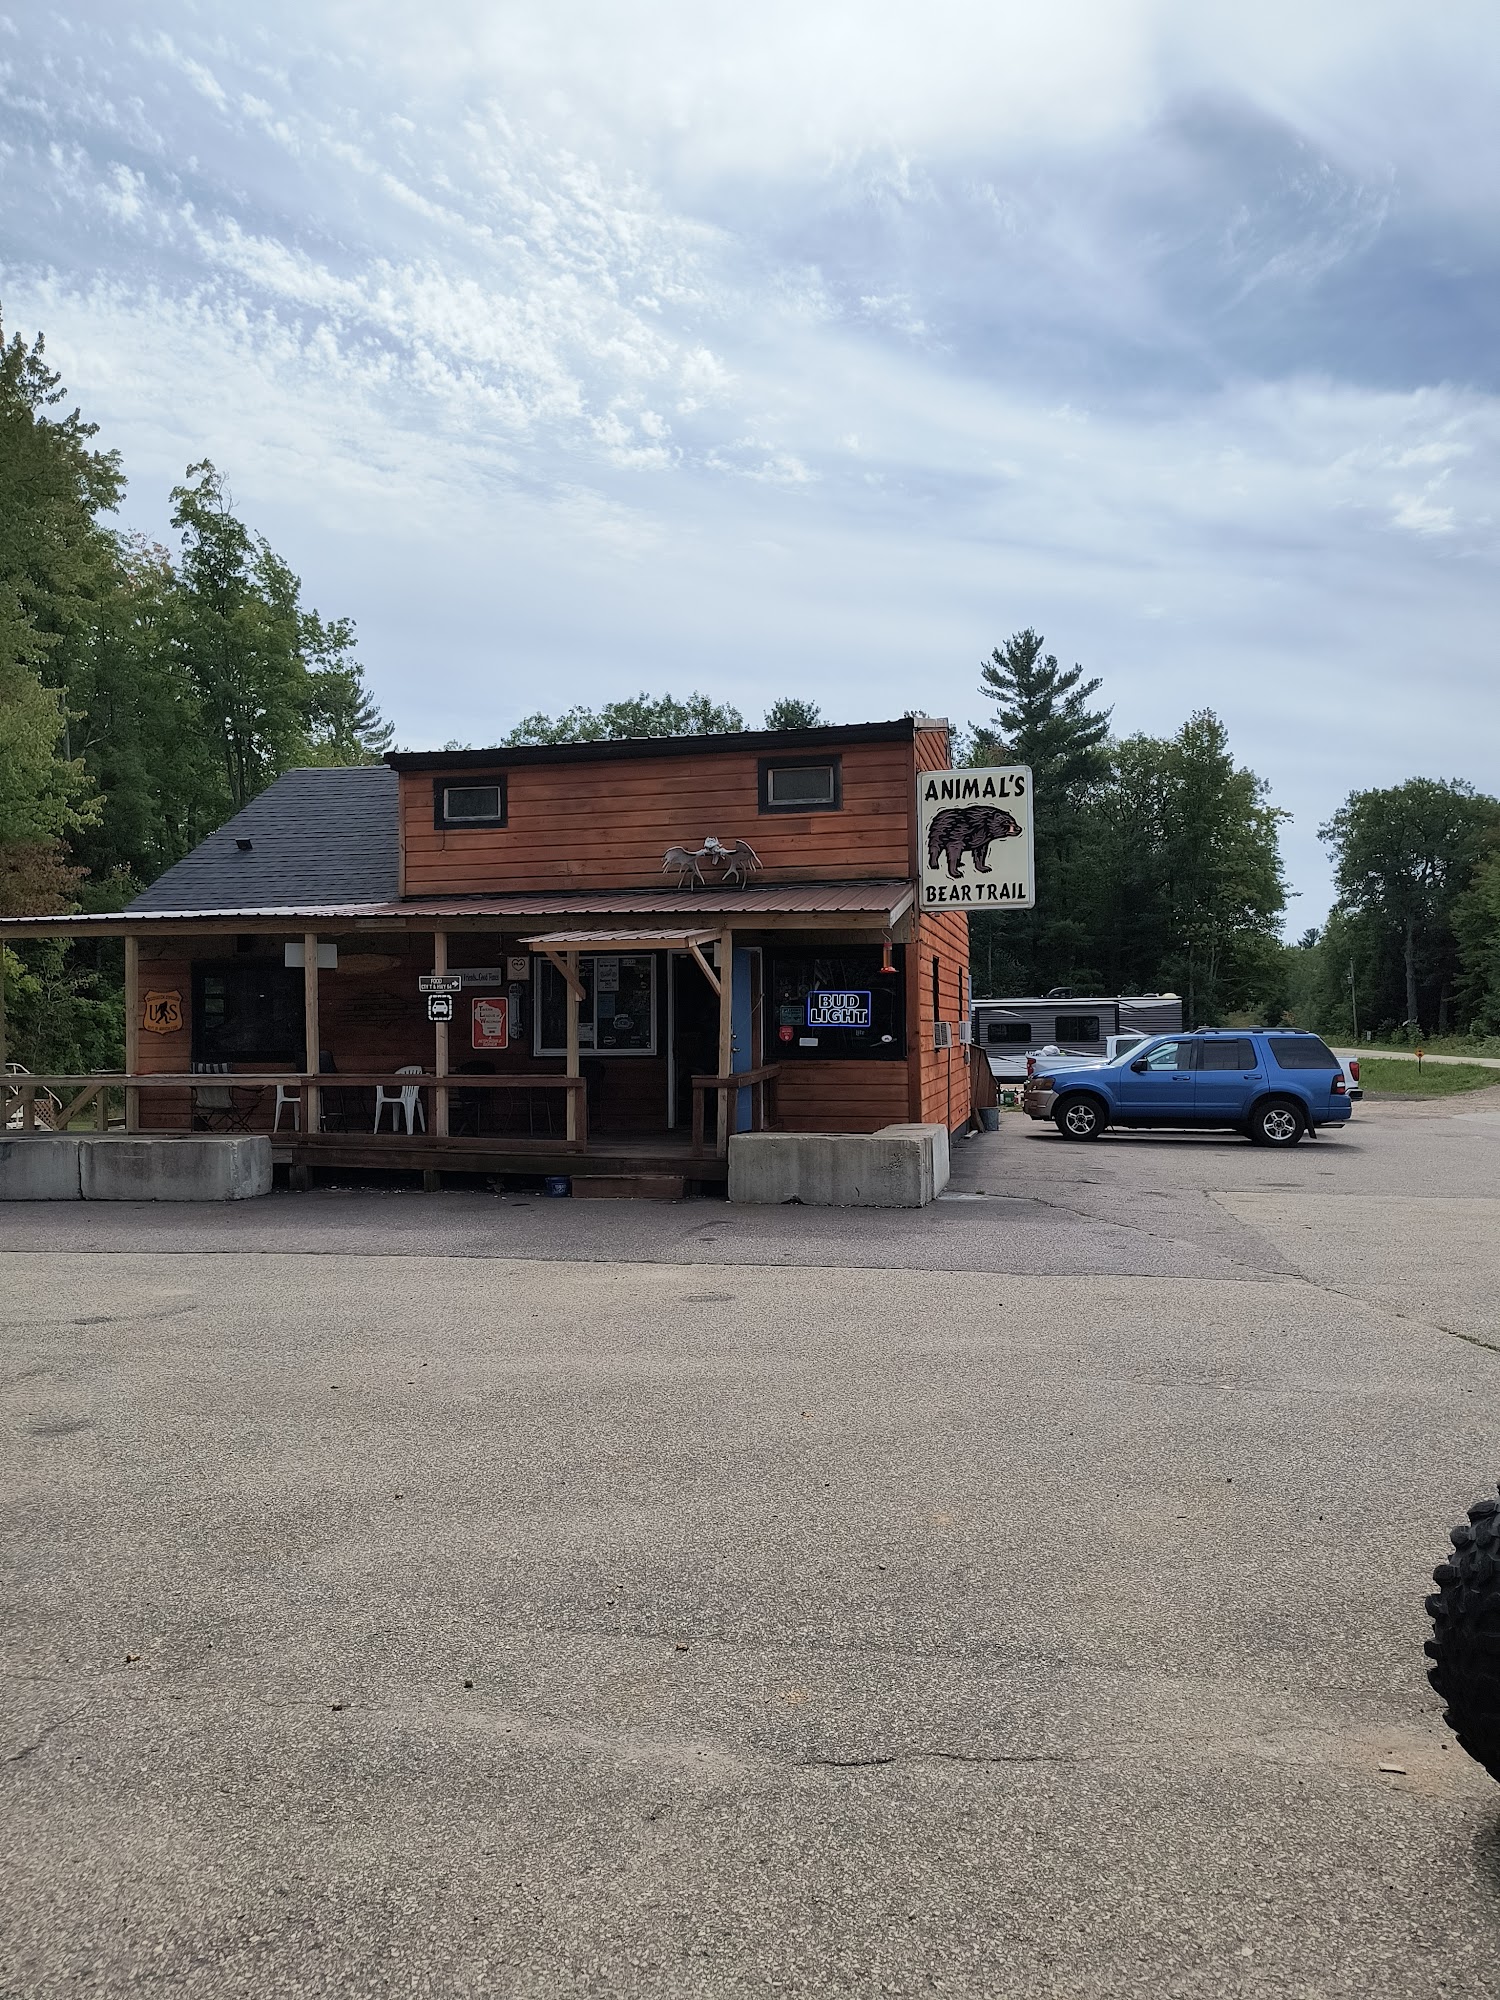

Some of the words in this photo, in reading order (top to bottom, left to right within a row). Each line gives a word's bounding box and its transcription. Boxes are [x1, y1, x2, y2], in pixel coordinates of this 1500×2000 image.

[925, 774, 1025, 802] ANIMAL'S
[926, 884, 972, 902] BEAR
[975, 882, 1026, 901] TRAIL
[818, 994, 860, 1009] BUD
